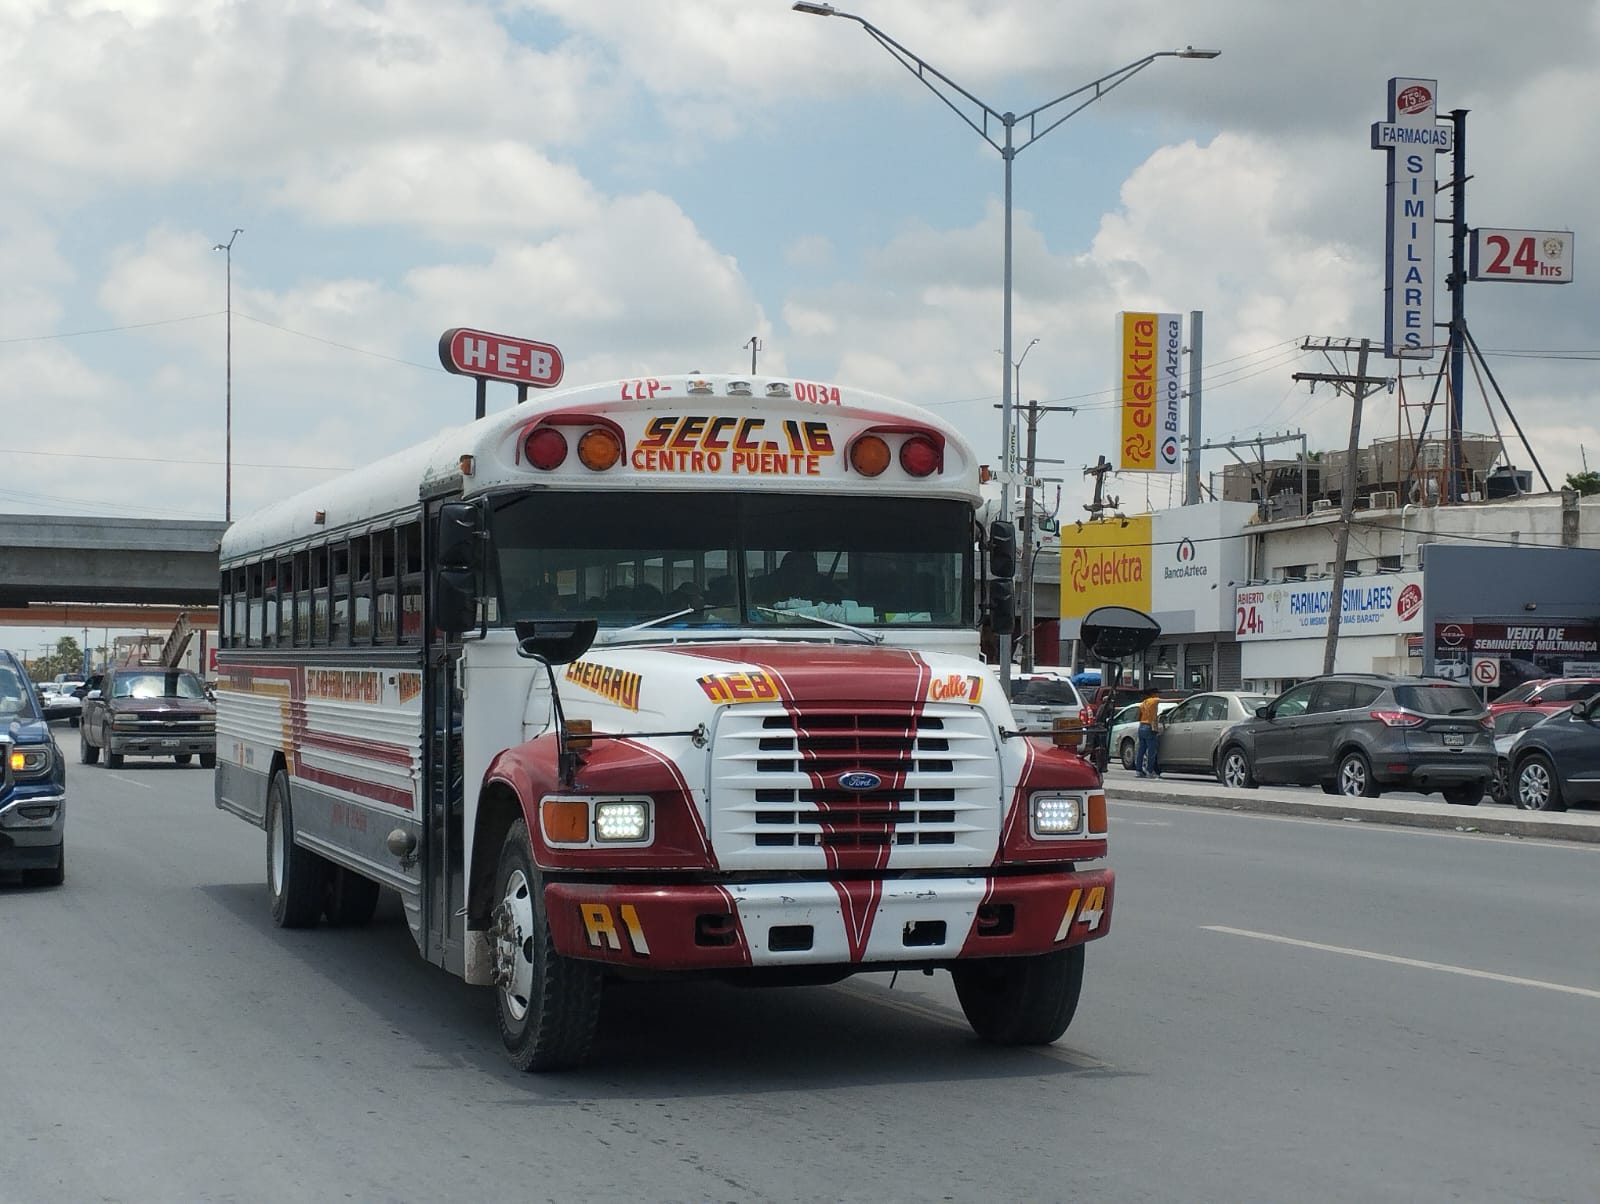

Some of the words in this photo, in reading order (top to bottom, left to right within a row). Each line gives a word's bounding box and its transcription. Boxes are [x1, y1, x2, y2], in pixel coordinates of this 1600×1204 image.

[1402, 90, 1426, 107] 75%
[1383, 127, 1447, 145] FARMACIAS
[1404, 155, 1425, 349] SIMILARES
[1166, 320, 1178, 378] Azteca
[1126, 319, 1153, 428] elektra
[794, 382, 840, 406] 0034
[1165, 381, 1177, 432] Banco
[781, 420, 835, 455] 16
[631, 449, 722, 473] CENTRO
[731, 452, 821, 475] PUENTE
[1091, 551, 1142, 586] elektra
[1164, 567, 1183, 579] Banco
[1183, 565, 1207, 577] Azteca
[1238, 592, 1264, 605] ABIERTO
[1342, 586, 1392, 612] SIMILARES
[1474, 639, 1534, 650] SEMINUEVOS
[1536, 641, 1597, 652] MULTIMARCA
[1507, 627, 1545, 640] VENTA
[1547, 628, 1565, 640] DE
[696, 671, 778, 704] HEB
[930, 674, 967, 701] Calle
[849, 775, 872, 786] Ford
[1054, 887, 1105, 942] 14
[580, 903, 650, 955] R1
